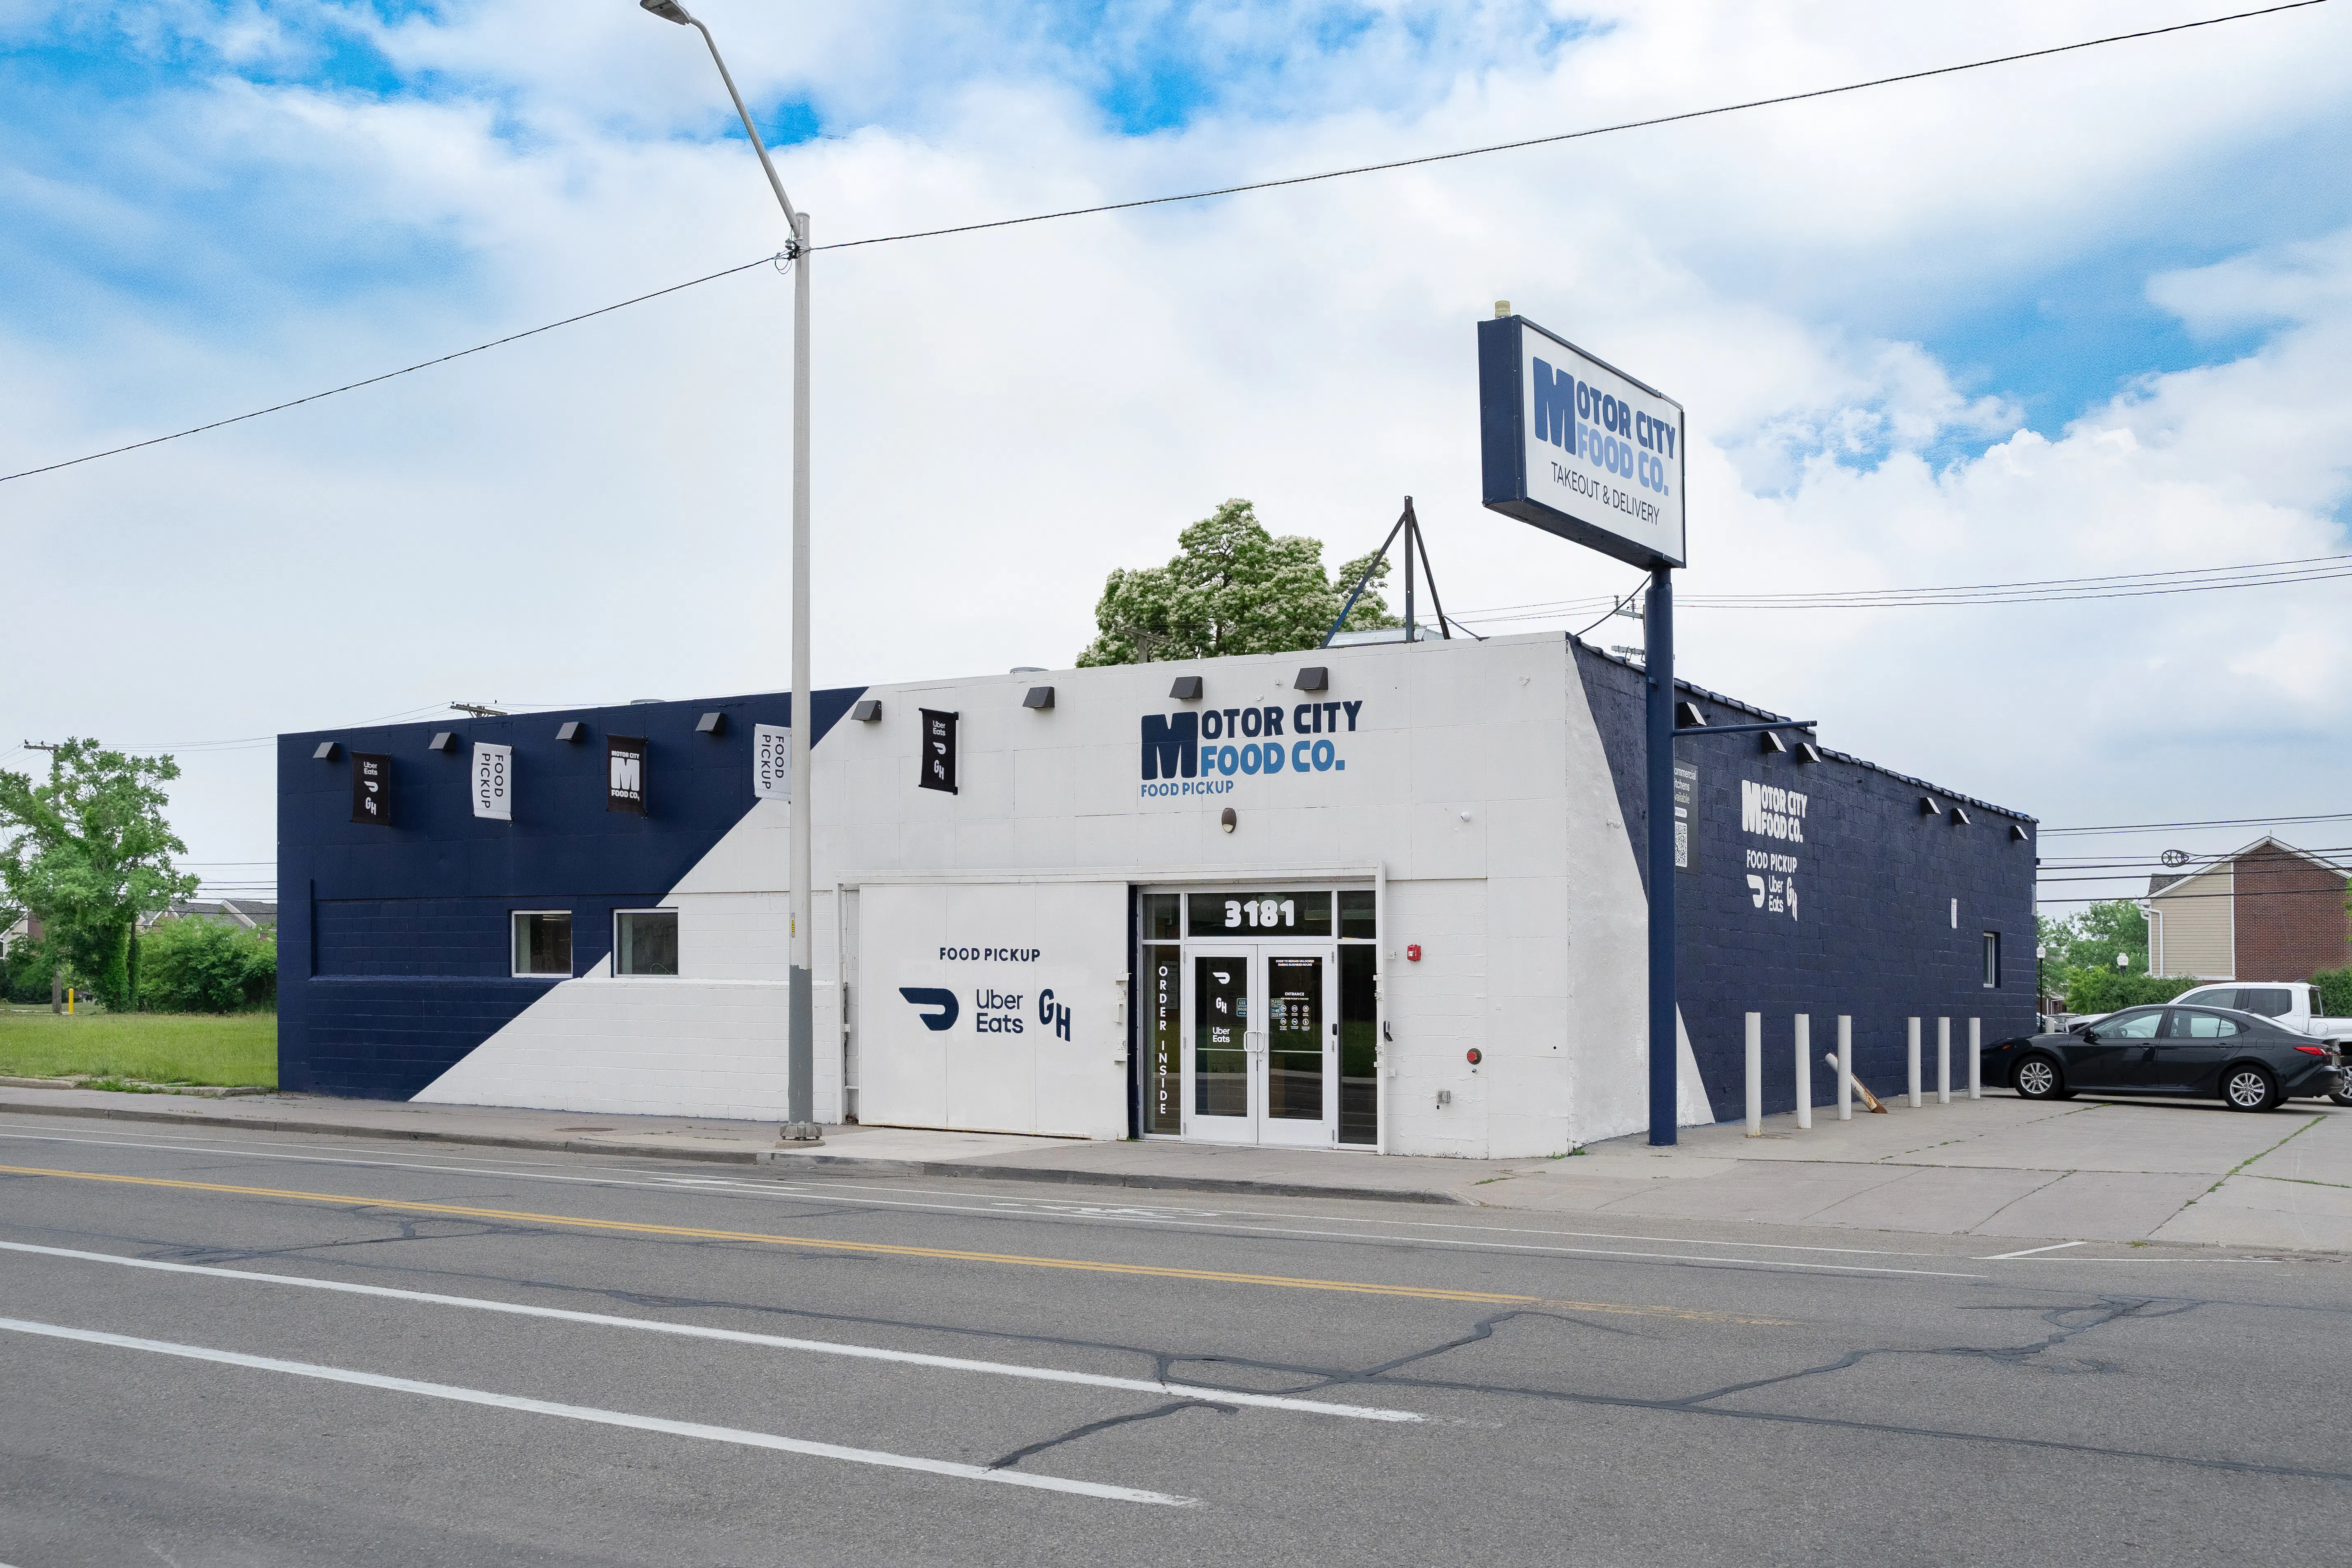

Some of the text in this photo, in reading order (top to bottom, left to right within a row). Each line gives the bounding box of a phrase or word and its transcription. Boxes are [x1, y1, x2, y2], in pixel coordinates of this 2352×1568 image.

[1533, 356, 1676, 459] MOTOR CITY
[1577, 422, 1669, 496] FOOD CO.
[1551, 461, 1660, 526] TAKEOUT & DELIVERY
[933, 720, 946, 729] Uber
[933, 727, 946, 736] Eats
[1141, 700, 1363, 780] MOTOR CITY
[761, 734, 771, 790] PICKUP
[774, 736, 785, 778] FOOD
[934, 760, 944, 780] GH
[1201, 739, 1345, 777] FOOD CO.
[480, 753, 491, 808] PICKUP
[494, 755, 504, 797] FOOD
[611, 757, 640, 791] M
[1674, 767, 1696, 781] ommercial
[1674, 778, 1690, 792] itchens
[611, 789, 629, 798] FOOD
[1141, 780, 1234, 797] FOOD PICKUP
[1674, 792, 1690, 804] vailable
[365, 797, 377, 815] GH
[1742, 780, 1807, 834] MOTOR CITY
[1761, 812, 1803, 843] FOOD CO.
[1747, 849, 1797, 873] FOOD PICKUP
[1769, 875, 1784, 893] Uber
[1225, 899, 1295, 927] 3181
[1769, 895, 1784, 913] Eats
[940, 947, 1041, 962] FOOD PICKUP
[976, 989, 1023, 1010] Uber
[1158, 966, 1168, 1031] ORDER
[1216, 997, 1227, 1014] GH
[976, 1012, 1024, 1034] Eats
[1039, 988, 1071, 1042] GH
[1159, 1040, 1167, 1114] INSIDE
